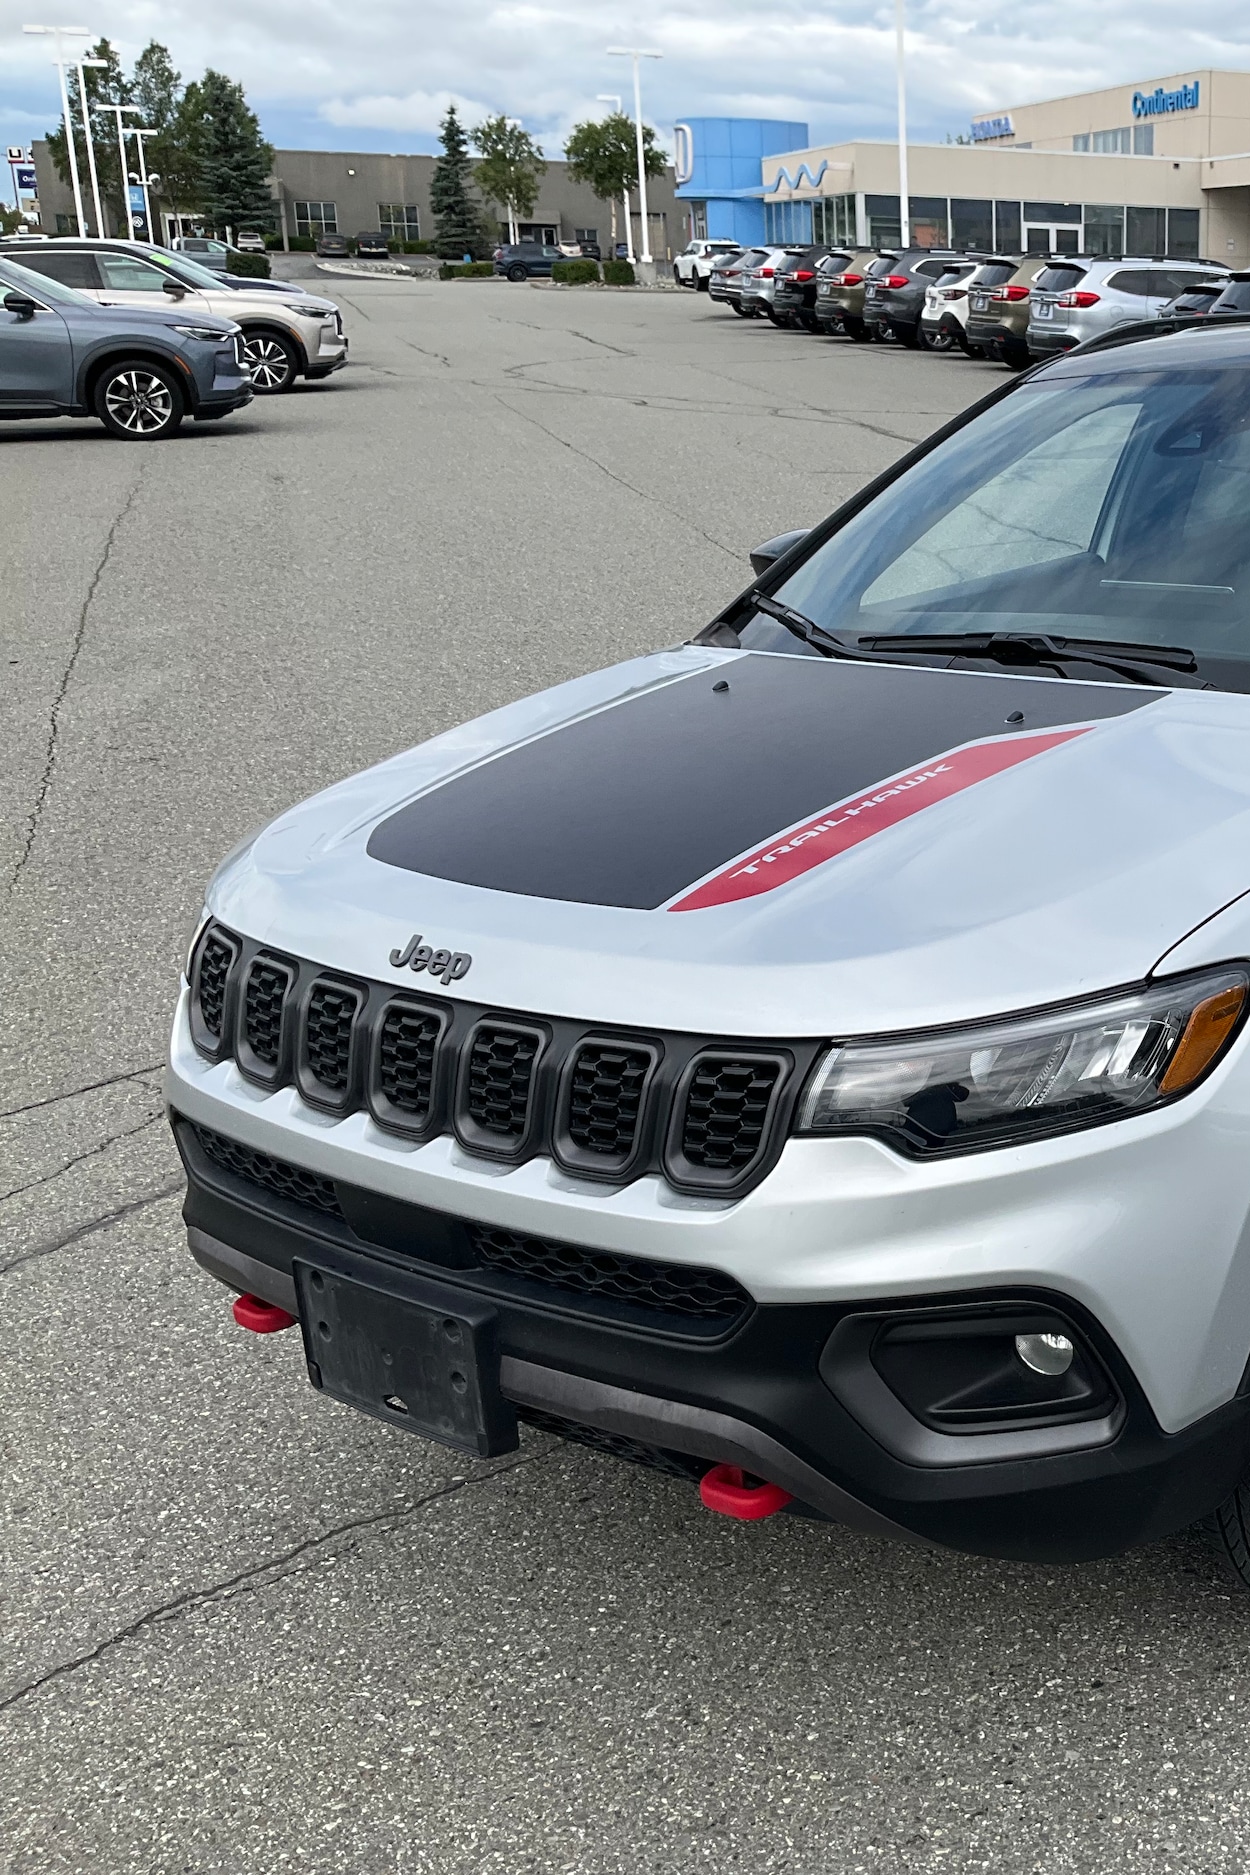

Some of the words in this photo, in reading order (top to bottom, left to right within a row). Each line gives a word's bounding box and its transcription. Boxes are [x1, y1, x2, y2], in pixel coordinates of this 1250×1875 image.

[1132, 81, 1200, 118] Continental
[728, 763, 956, 880] TRAILHAWK
[389, 933, 473, 986] Jeep
